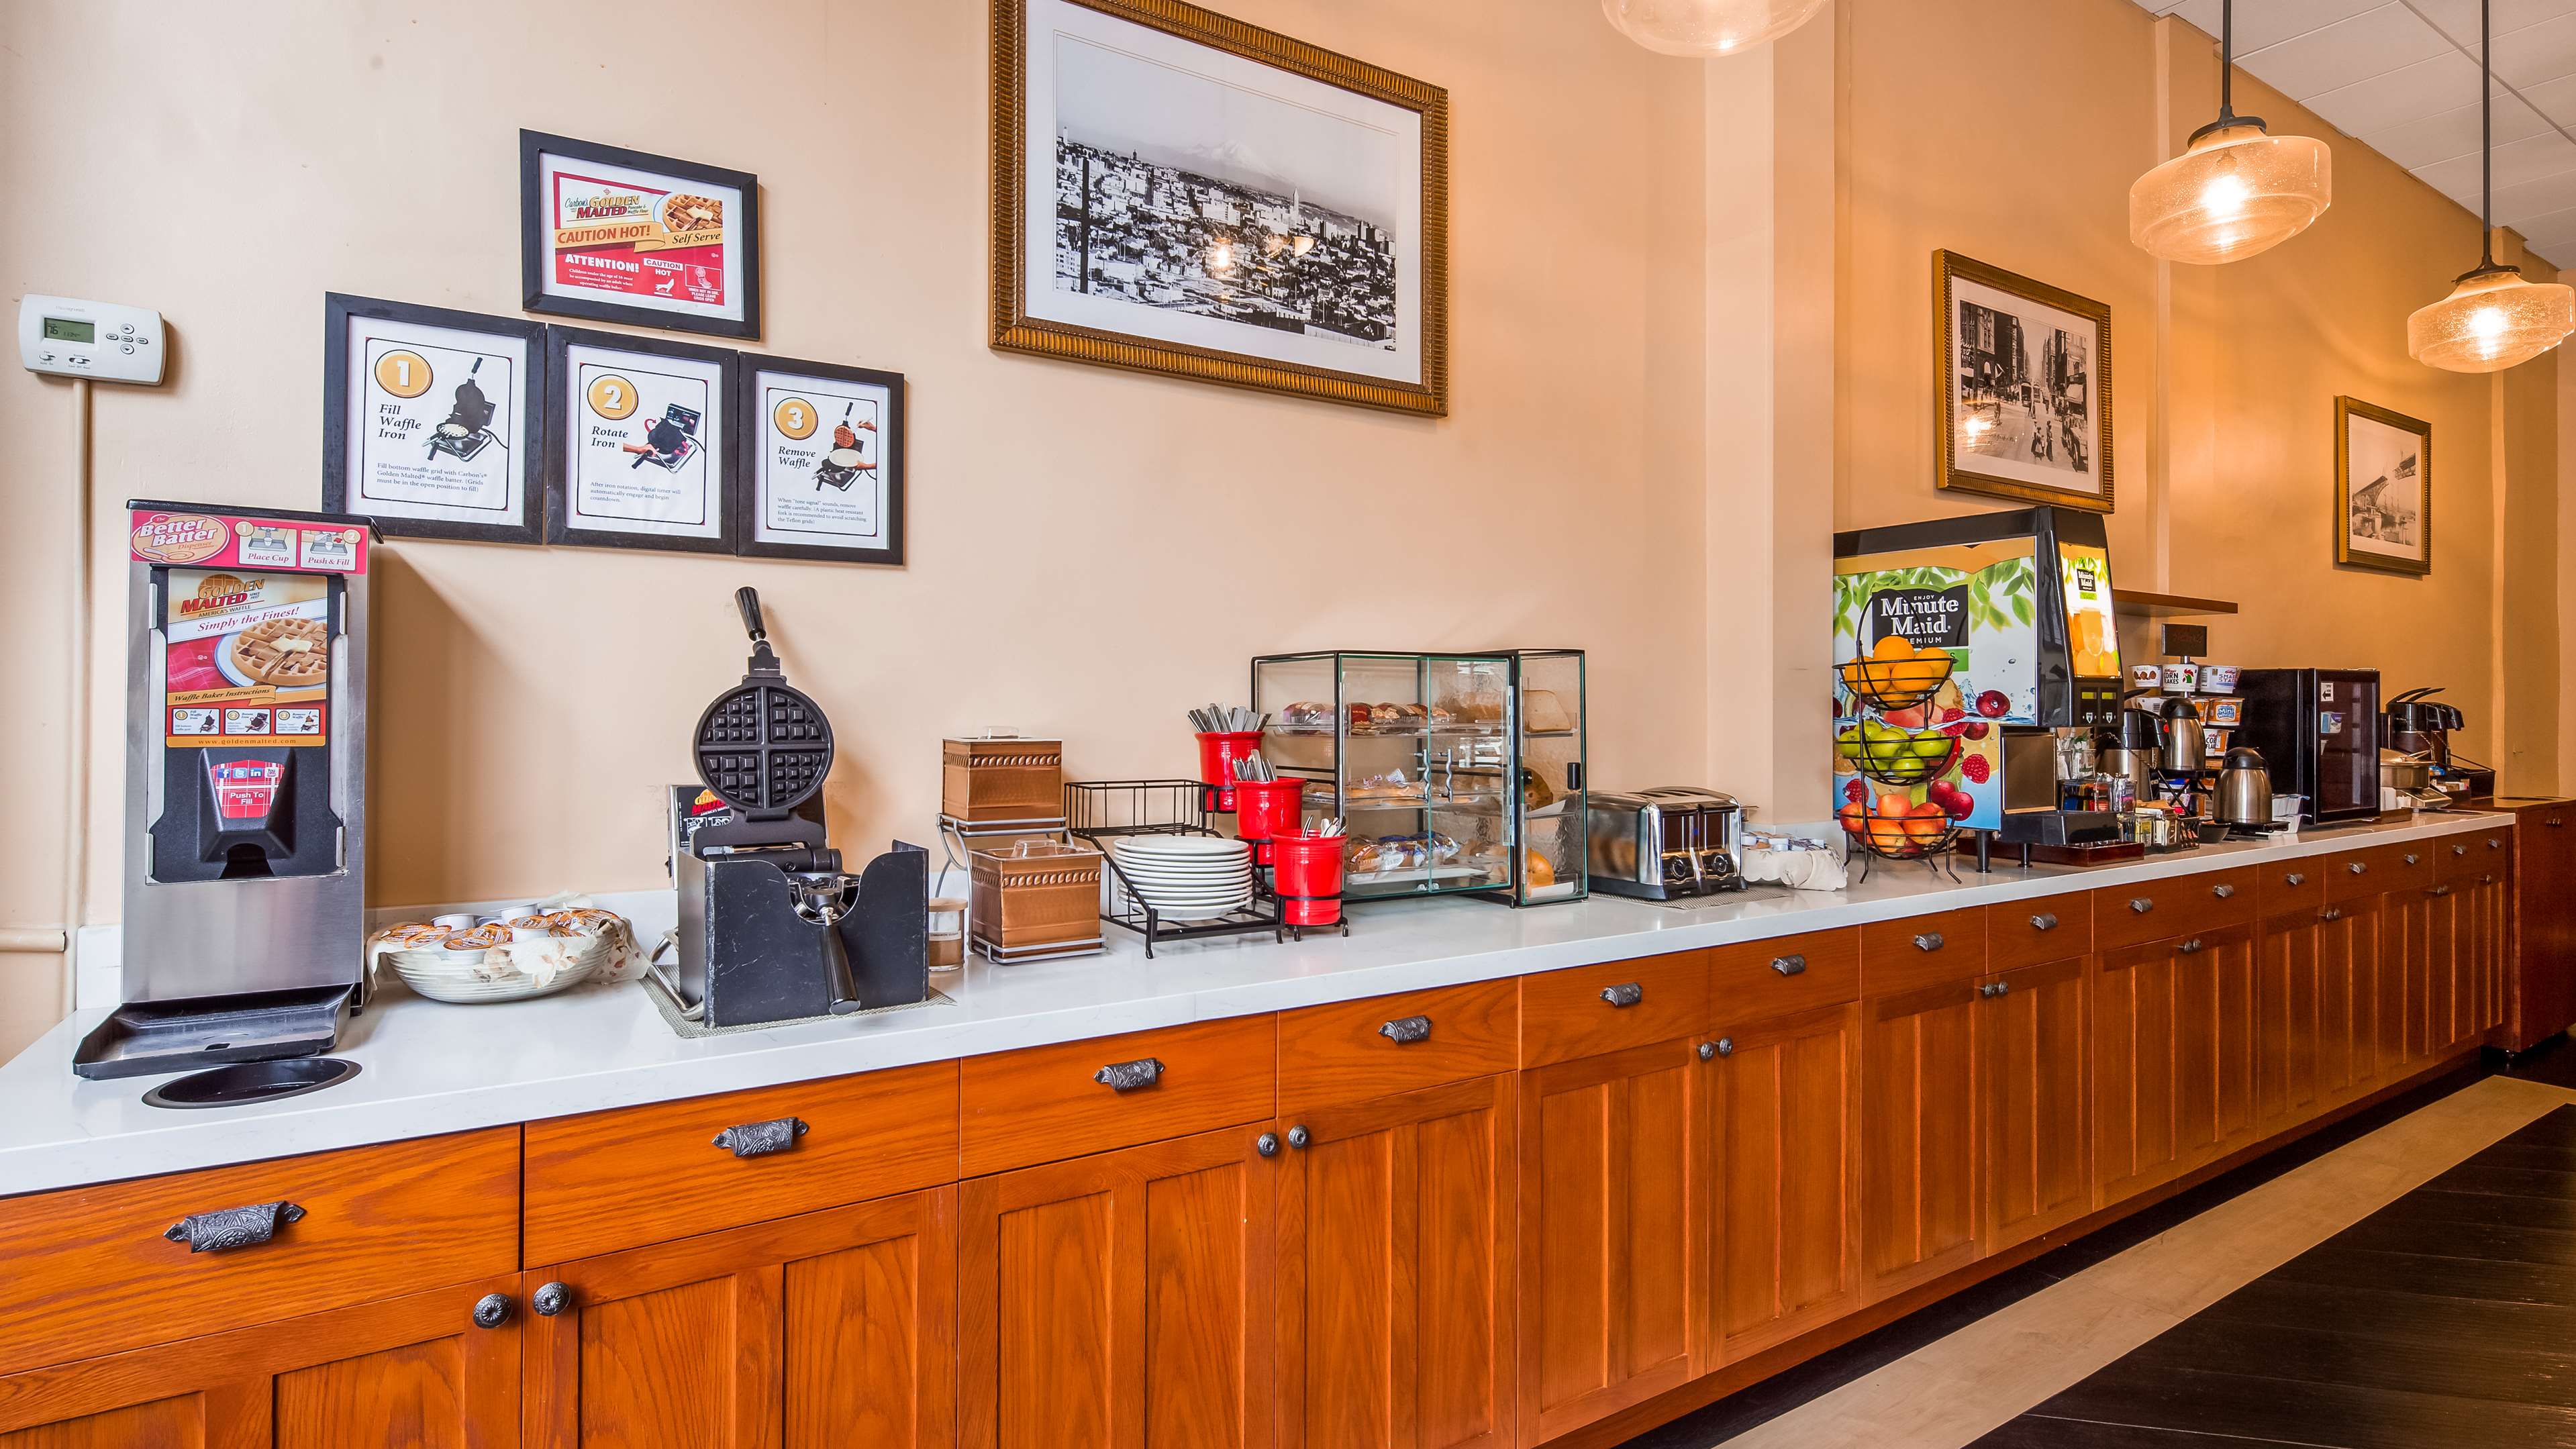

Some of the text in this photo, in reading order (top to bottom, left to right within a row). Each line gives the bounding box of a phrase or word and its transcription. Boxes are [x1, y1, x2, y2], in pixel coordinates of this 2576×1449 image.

[565, 195, 640, 208] Carbon's GOLDEN
[577, 205, 628, 218] MALTED
[557, 225, 650, 244] CAUTION HOT!
[673, 233, 720, 245] Self Serve
[565, 254, 640, 273] ATTENTION!
[646, 260, 681, 269] CAUTION
[397, 360, 410, 387] 1
[604, 385, 622, 410] 2
[379, 404, 401, 415] Fill
[380, 416, 422, 431] Waffle
[787, 407, 803, 430] 3
[378, 428, 405, 440] Iron
[591, 426, 628, 439] Rotate
[591, 438, 615, 448] Iron
[779, 446, 816, 458] Remove
[779, 456, 811, 469] Waffle
[590, 489, 625, 497] automatically
[139, 519, 207, 538] Better
[242, 524, 247, 533] 1
[151, 528, 218, 547] Batter
[347, 532, 356, 540] 2
[178, 542, 212, 550] Dispenser
[272, 554, 289, 563] Cup
[198, 579, 265, 599] GOLDEN
[181, 592, 248, 613] MALTED
[1881, 596, 1959, 616] Minute
[198, 604, 251, 618] AMERICA'S WAFFLE
[197, 606, 299, 632] Simply the Finest!
[1891, 614, 1948, 636] Maid
[226, 687, 270, 697] Instructions
